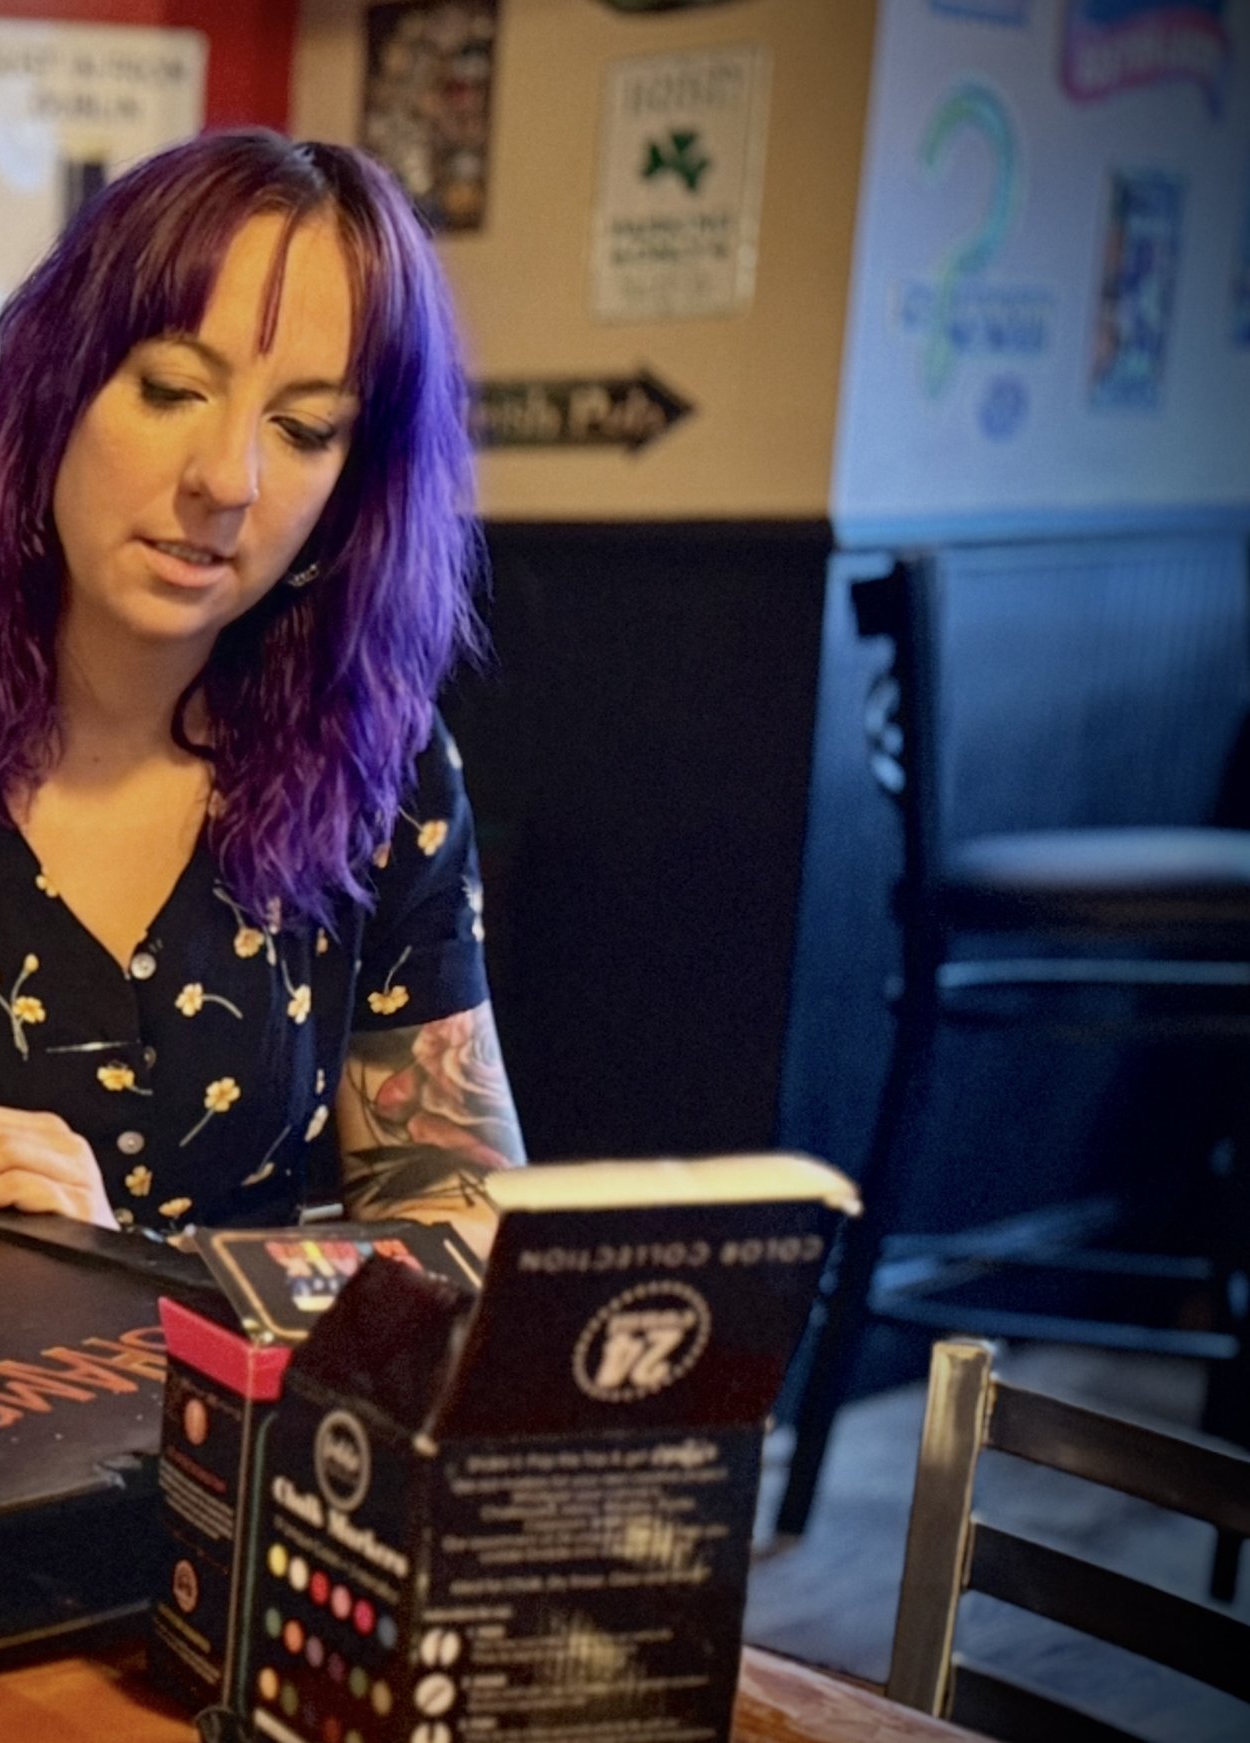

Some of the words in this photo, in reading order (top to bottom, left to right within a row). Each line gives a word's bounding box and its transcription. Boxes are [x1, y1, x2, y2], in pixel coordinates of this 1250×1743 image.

[516, 1240, 712, 1273] COLLECTION
[720, 1233, 825, 1266] COLOR
[595, 1329, 685, 1389] 24
[271, 1475, 325, 1529] Chalk
[327, 1507, 410, 1579] Markers
